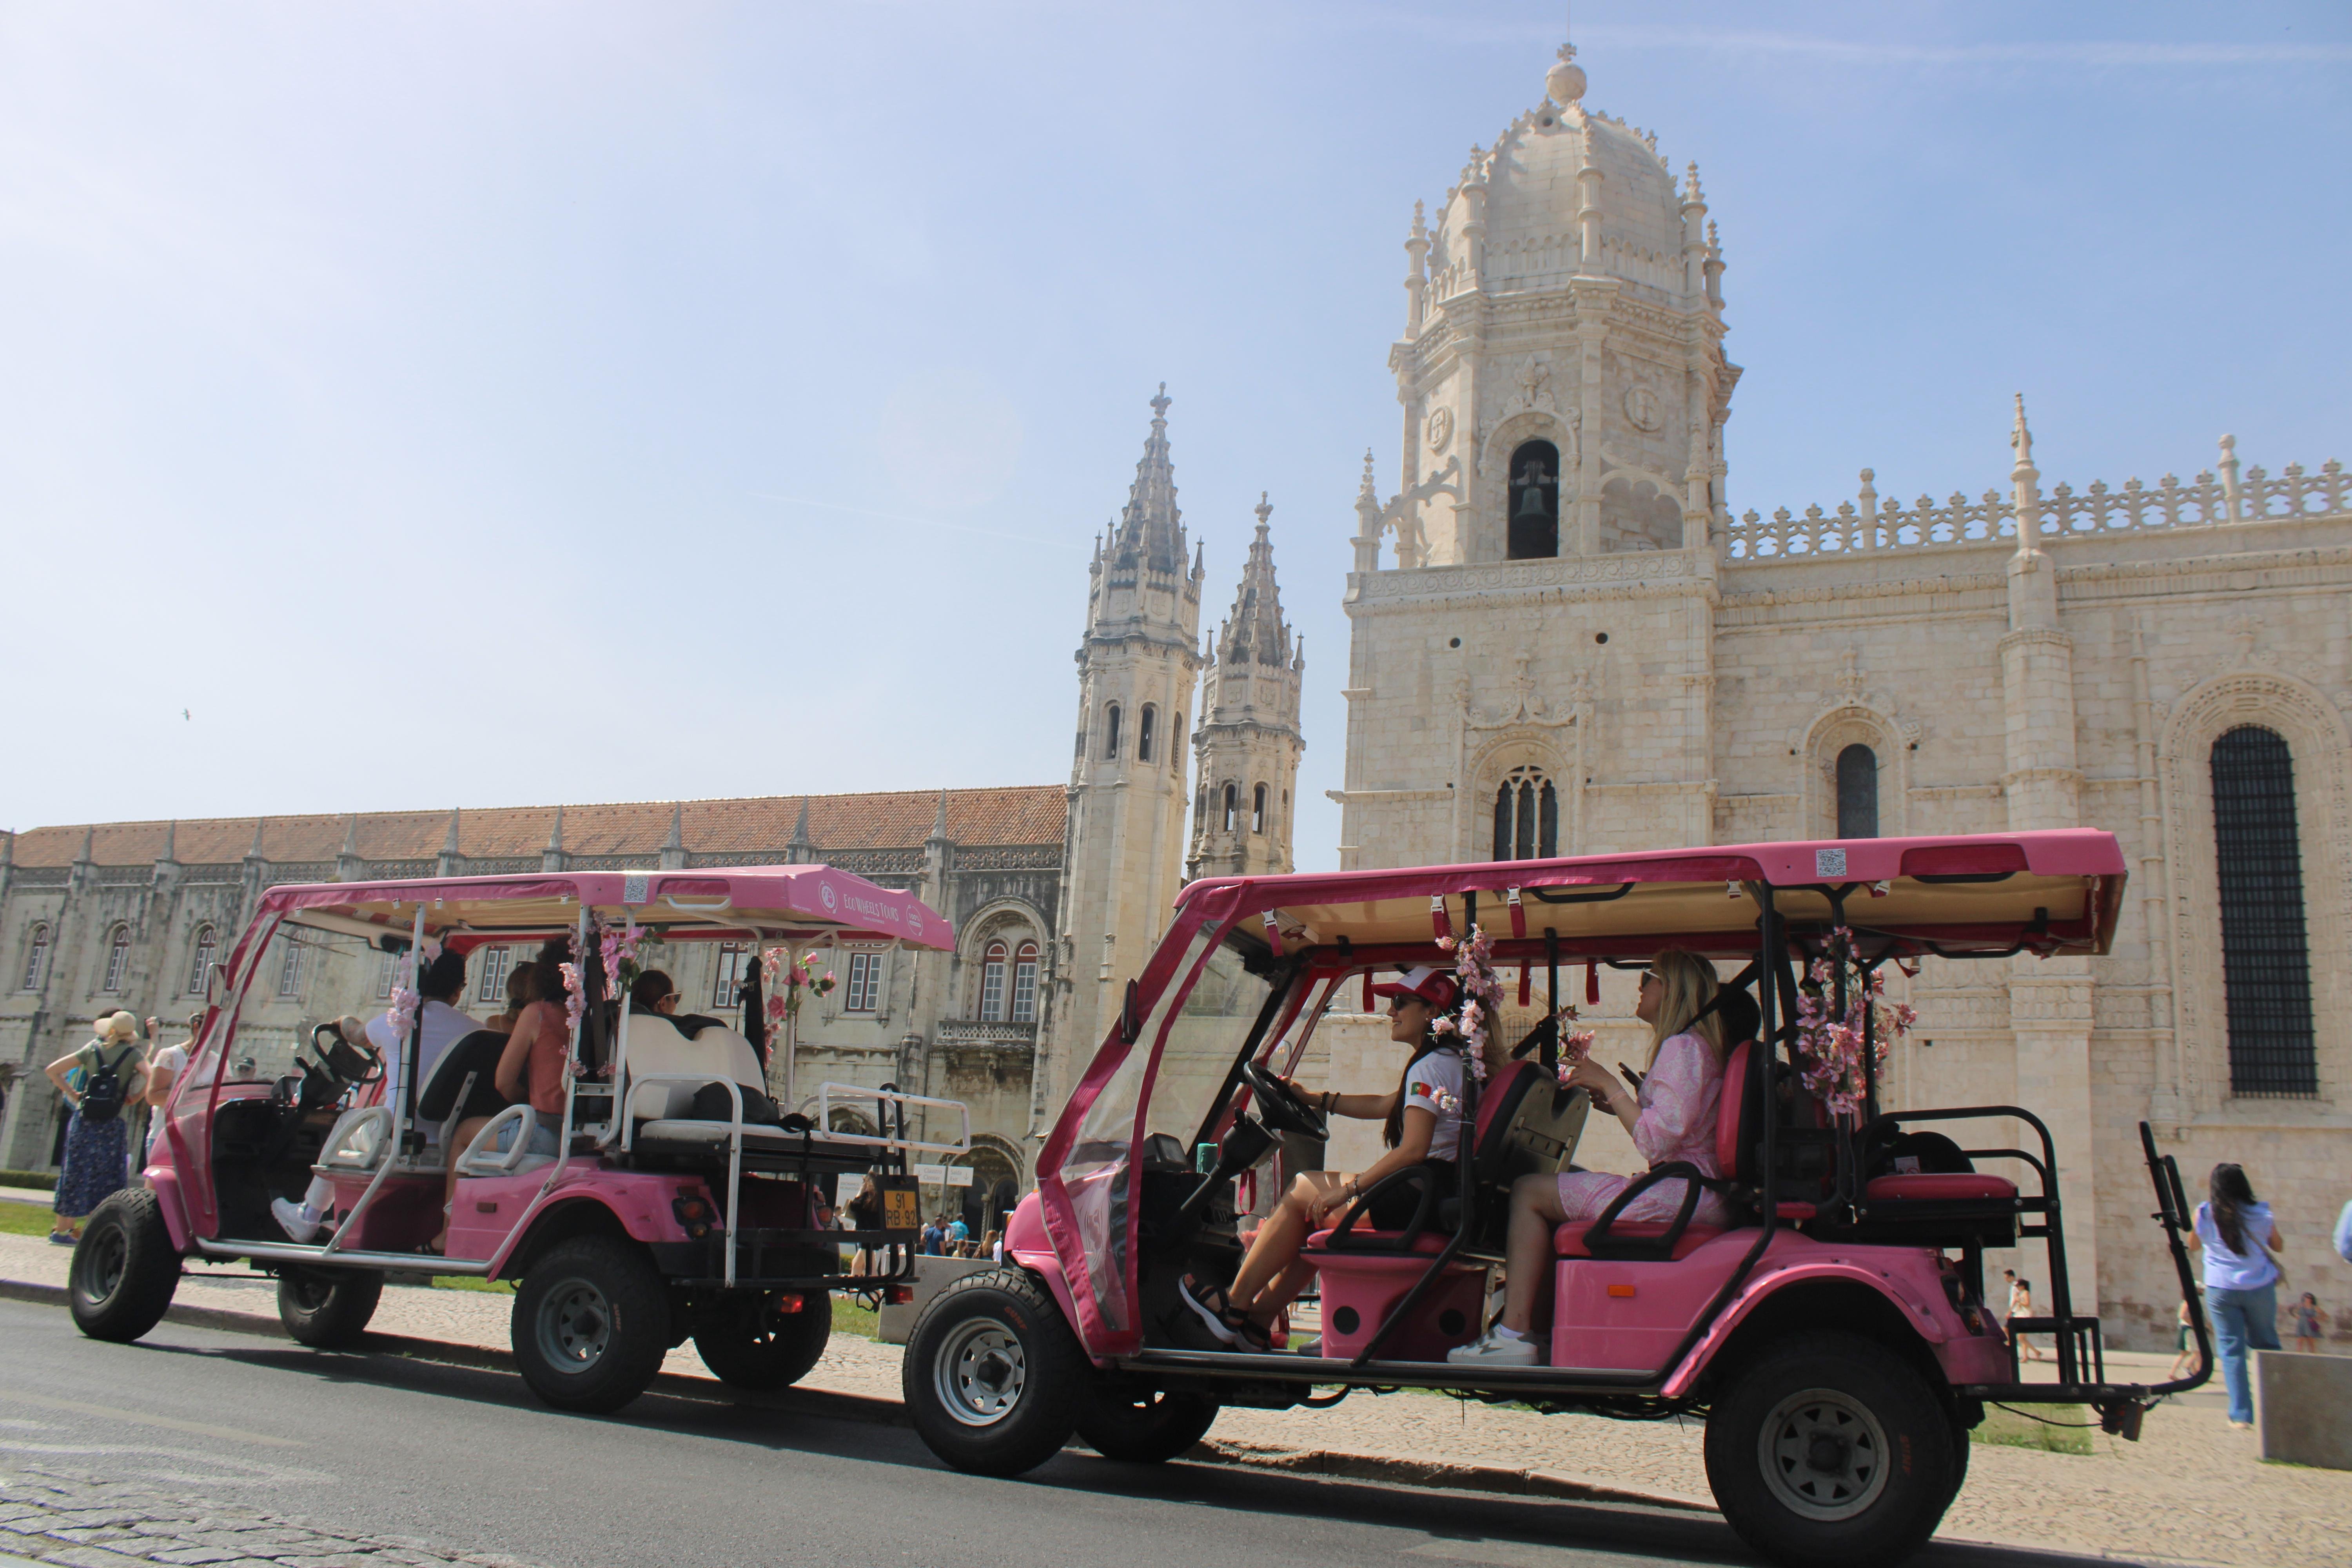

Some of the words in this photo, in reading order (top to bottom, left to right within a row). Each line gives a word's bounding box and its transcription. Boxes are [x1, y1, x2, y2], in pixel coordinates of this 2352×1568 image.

[879, 903, 899, 922] TOURS
[909, 913, 920, 922] 100%
[896, 1193, 905, 1209] 91
[1004, 1306, 1027, 1330] SUNF
